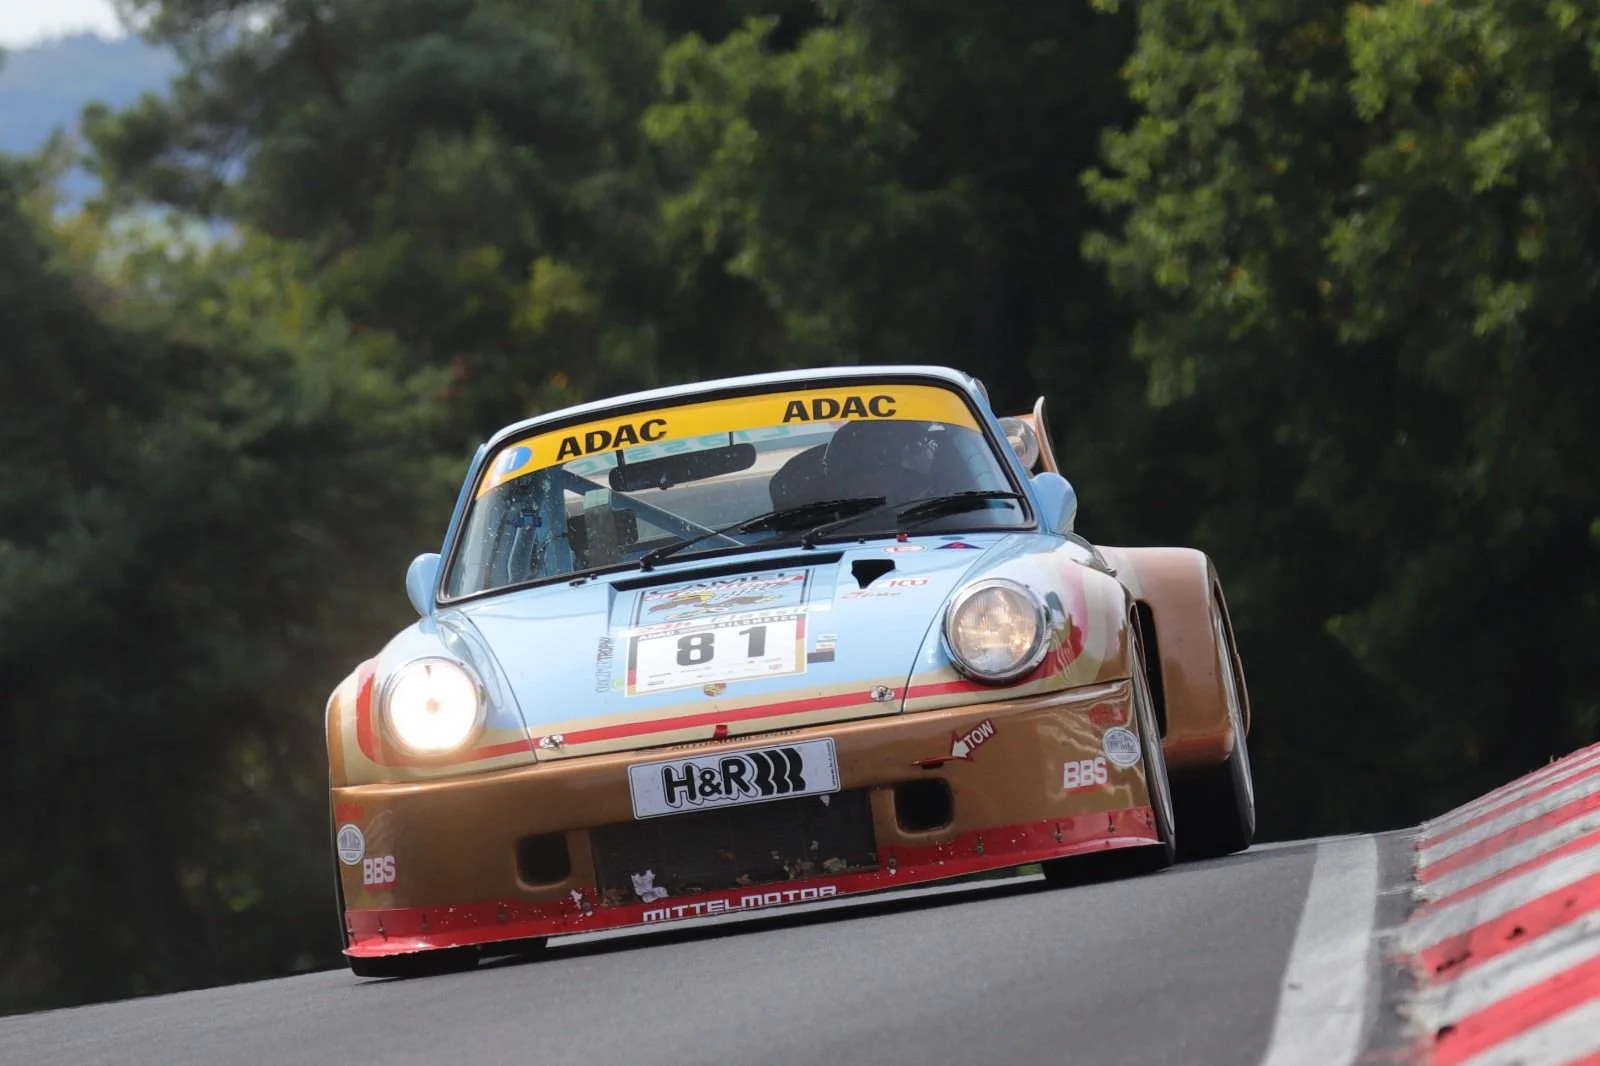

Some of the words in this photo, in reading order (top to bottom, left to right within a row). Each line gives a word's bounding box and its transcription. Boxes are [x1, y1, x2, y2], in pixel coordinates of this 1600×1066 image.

[783, 395, 897, 423] ADAC
[556, 419, 667, 461] ADAC
[676, 626, 767, 666] 81
[964, 720, 994, 749] TOW
[662, 757, 754, 805] H&R
[1064, 757, 1107, 789] BBS
[363, 855, 396, 885] BBS
[643, 886, 837, 922] MITTELMOTOR
